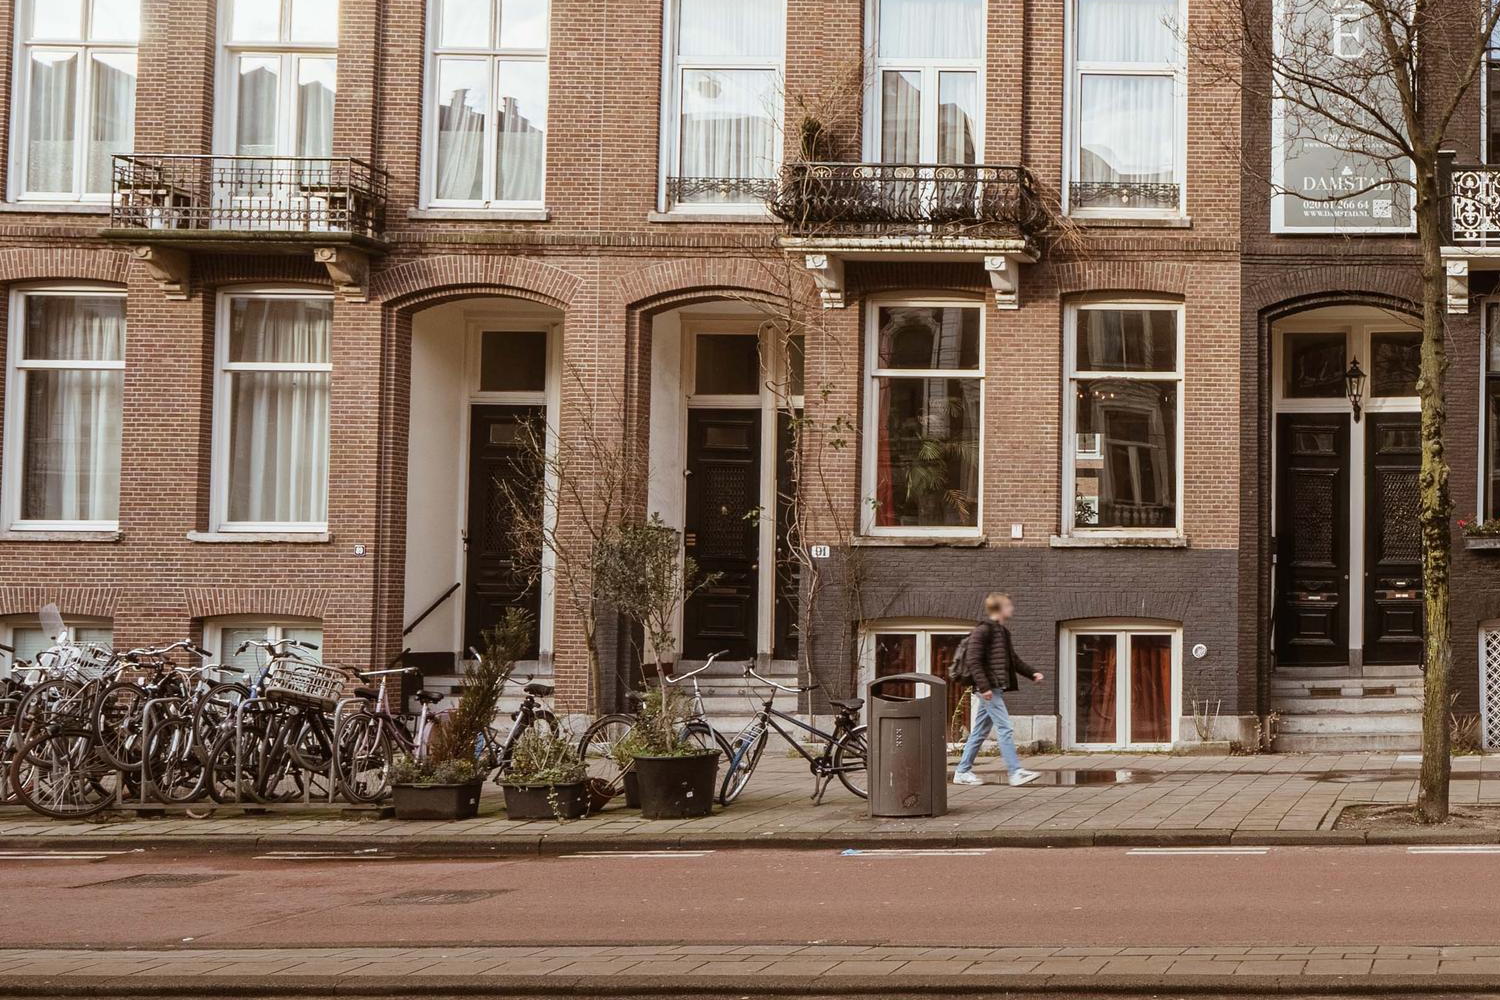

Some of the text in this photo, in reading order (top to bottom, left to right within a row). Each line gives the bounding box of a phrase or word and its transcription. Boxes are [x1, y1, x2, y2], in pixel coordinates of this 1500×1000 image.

[1303, 176, 1391, 191] DAMSTAD
[1303, 200, 1320, 210] 020
[1357, 200, 1369, 210] 64
[815, 546, 827, 557] 91
